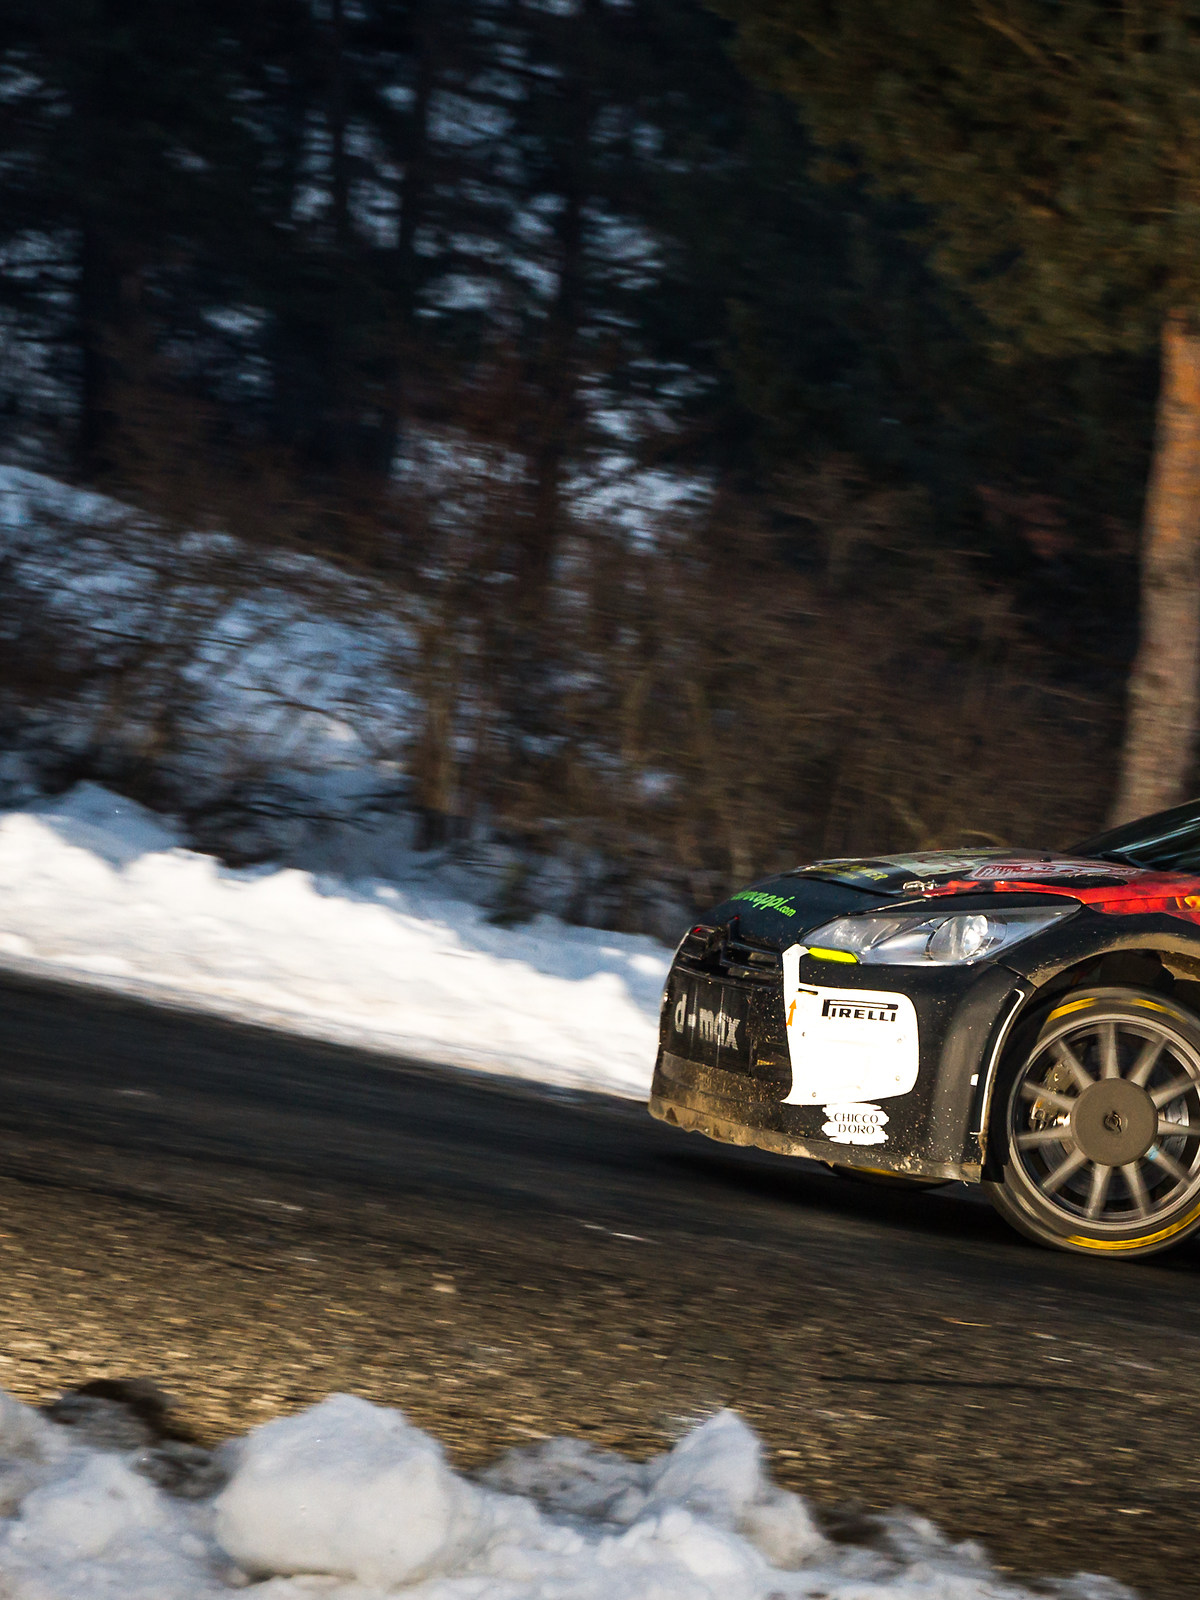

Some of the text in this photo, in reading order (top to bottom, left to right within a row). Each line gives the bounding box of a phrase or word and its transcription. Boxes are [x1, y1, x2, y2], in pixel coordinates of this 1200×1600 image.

[675, 994, 740, 1050] d-max
[821, 999, 899, 1022] PIRELLI
[834, 1112, 879, 1124] CHICCO
